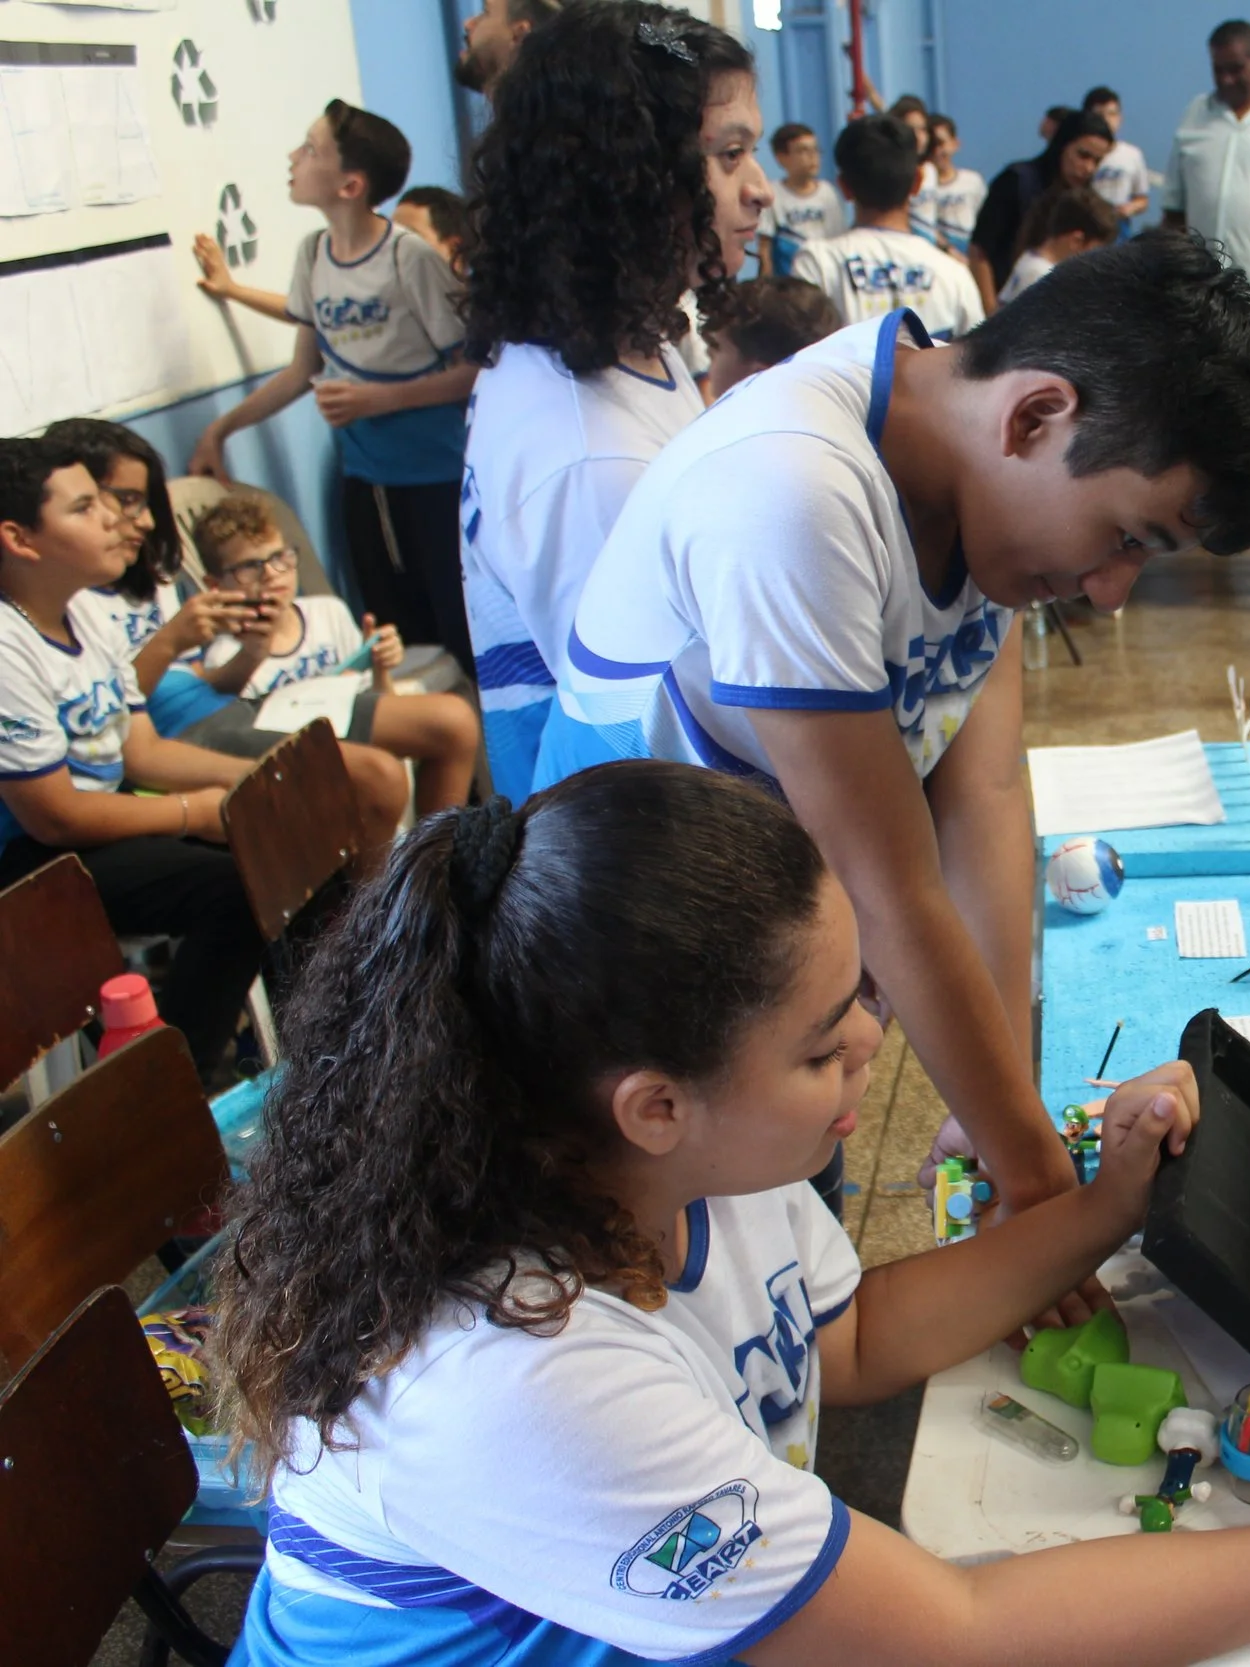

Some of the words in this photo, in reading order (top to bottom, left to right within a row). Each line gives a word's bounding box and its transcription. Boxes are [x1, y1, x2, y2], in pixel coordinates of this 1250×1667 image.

[615, 1564, 627, 1591] CENTRO
[653, 1511, 683, 1538] ANTONIO
[715, 1484, 747, 1497] TAVARES
[661, 1519, 763, 1601] CEART
